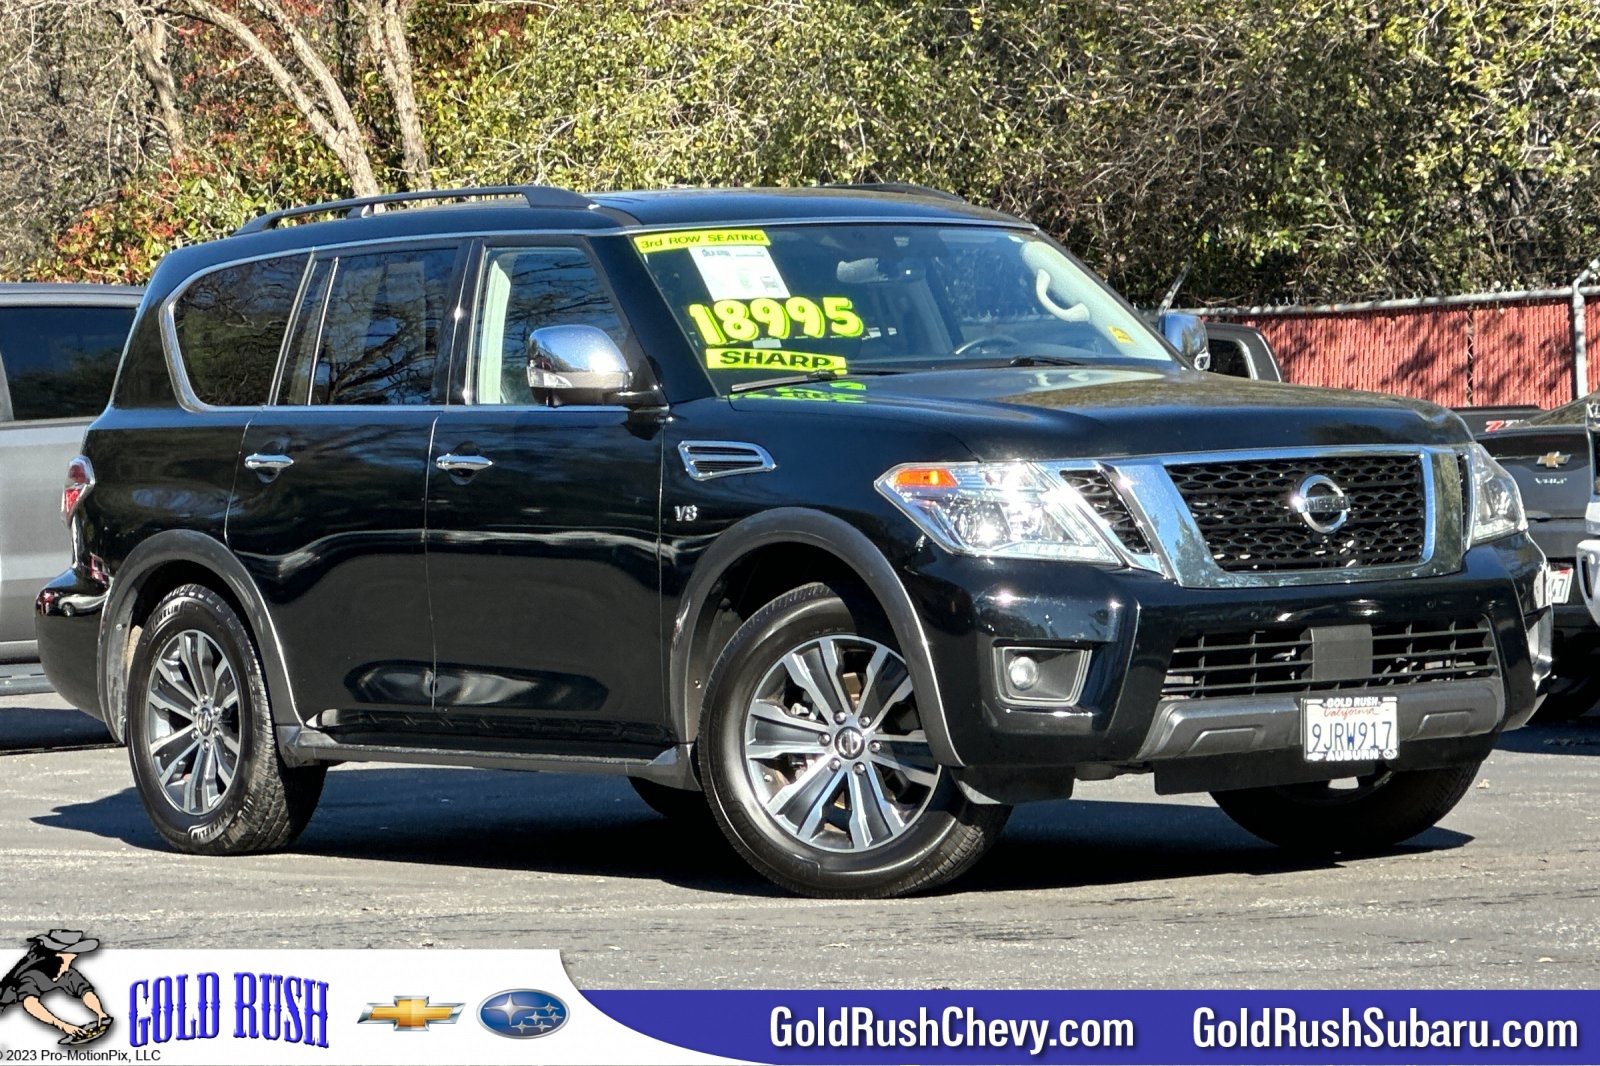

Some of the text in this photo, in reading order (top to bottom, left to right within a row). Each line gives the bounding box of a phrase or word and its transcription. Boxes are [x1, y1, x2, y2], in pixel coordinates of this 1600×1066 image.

[641, 234, 764, 249] 3rd ROW SEATING
[689, 296, 864, 345] 18995
[720, 351, 831, 368] SHARP
[674, 505, 698, 521] V8
[1326, 696, 1379, 707] GOLD RUSH
[1324, 707, 1379, 720] California
[1312, 721, 1392, 753] 9JRW917
[1326, 750, 1379, 761] AUBURN
